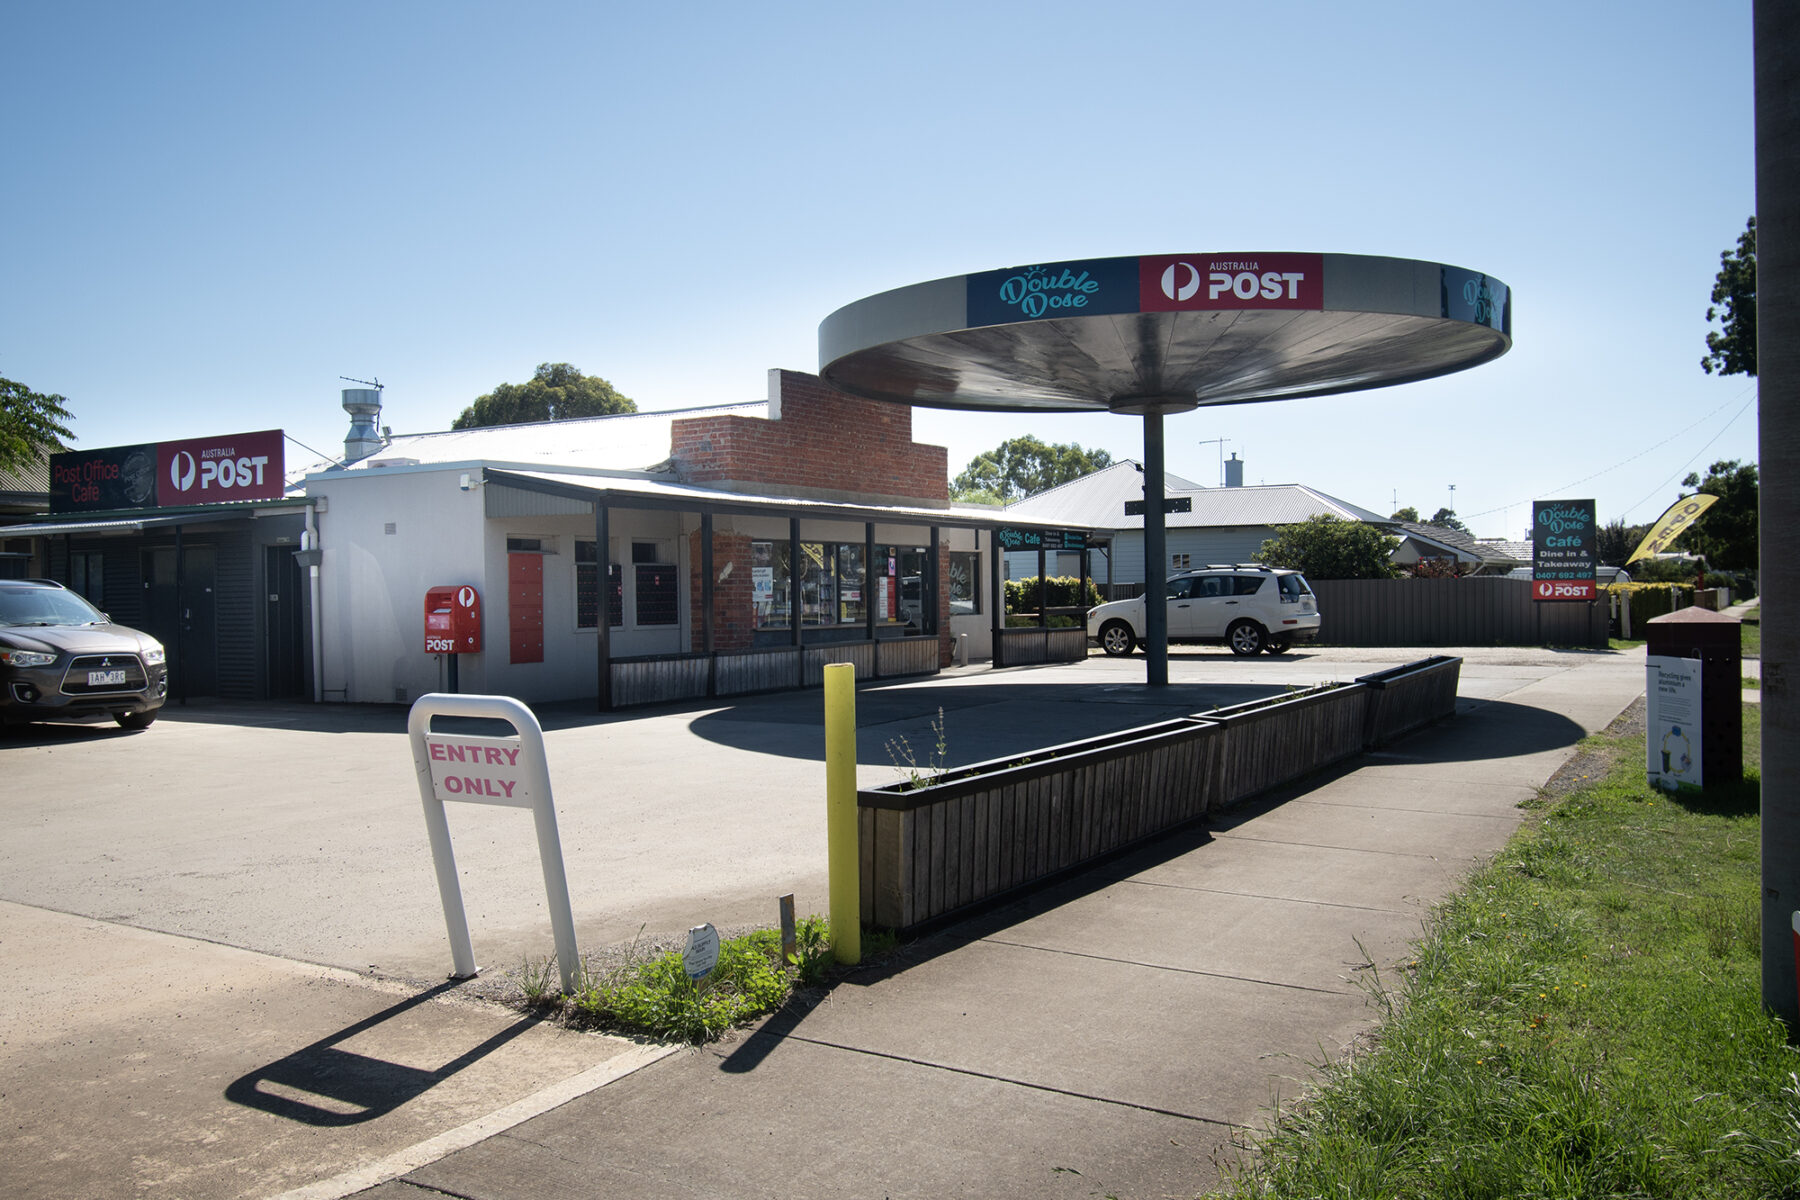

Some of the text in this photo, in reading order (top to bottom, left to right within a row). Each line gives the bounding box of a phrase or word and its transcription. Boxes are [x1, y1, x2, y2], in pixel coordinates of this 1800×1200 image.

[1209, 261, 1259, 271] AUSTRALIA
[1000, 268, 1099, 304] Double
[1209, 271, 1304, 300] POST
[1021, 292, 1089, 318] Dose
[201, 447, 236, 459] AUSTRALIA
[55, 464, 81, 484] Post
[83, 459, 119, 482] Office
[201, 456, 268, 490] POST
[72, 483, 100, 503] Cafe
[1538, 506, 1591, 526] Double
[1550, 519, 1585, 534] Dose
[1645, 502, 1700, 554] OPEN
[1024, 533, 1040, 545] Cafe
[1545, 535, 1582, 547] Café
[1537, 561, 1592, 569] Takeaway
[1555, 586, 1589, 597] POST
[426, 639, 455, 651] POST
[429, 743, 521, 766] ENTRY
[444, 775, 517, 798] ONLY
